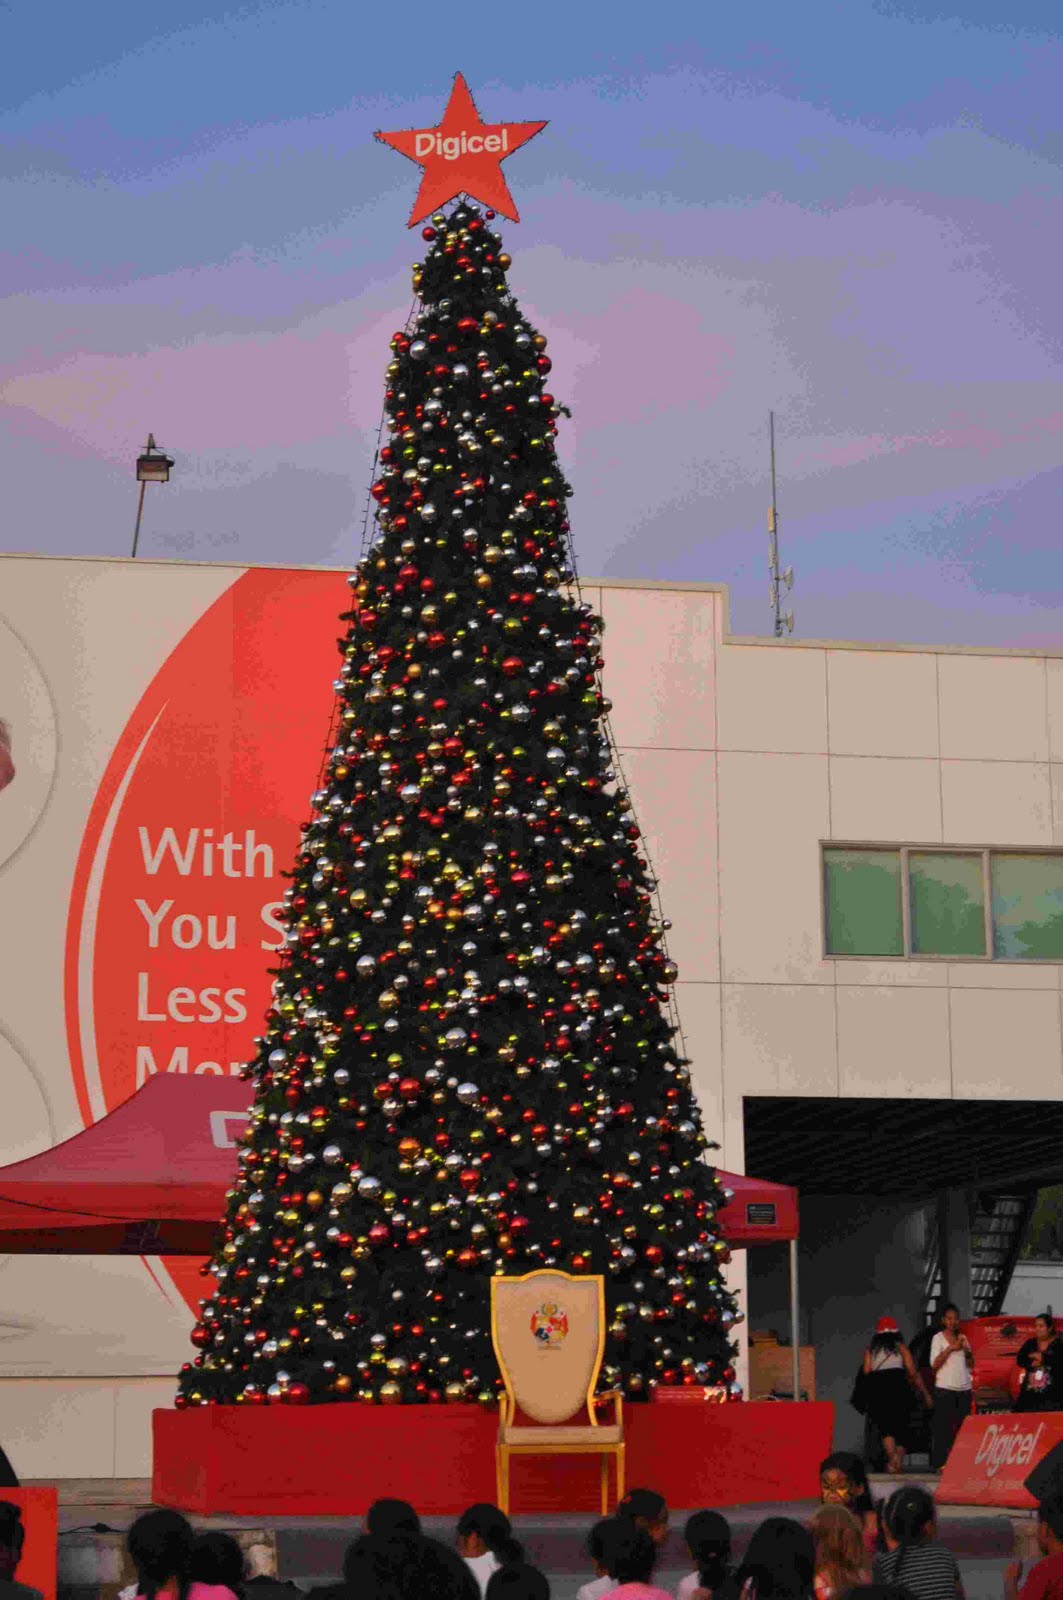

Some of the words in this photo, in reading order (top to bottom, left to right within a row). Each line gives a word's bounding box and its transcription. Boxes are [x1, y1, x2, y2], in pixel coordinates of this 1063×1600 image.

[415, 128, 508, 160] Digicel
[138, 826, 274, 878] With
[134, 898, 237, 950] You
[137, 971, 248, 1024] Less
[974, 1422, 1044, 1477] Digicel
